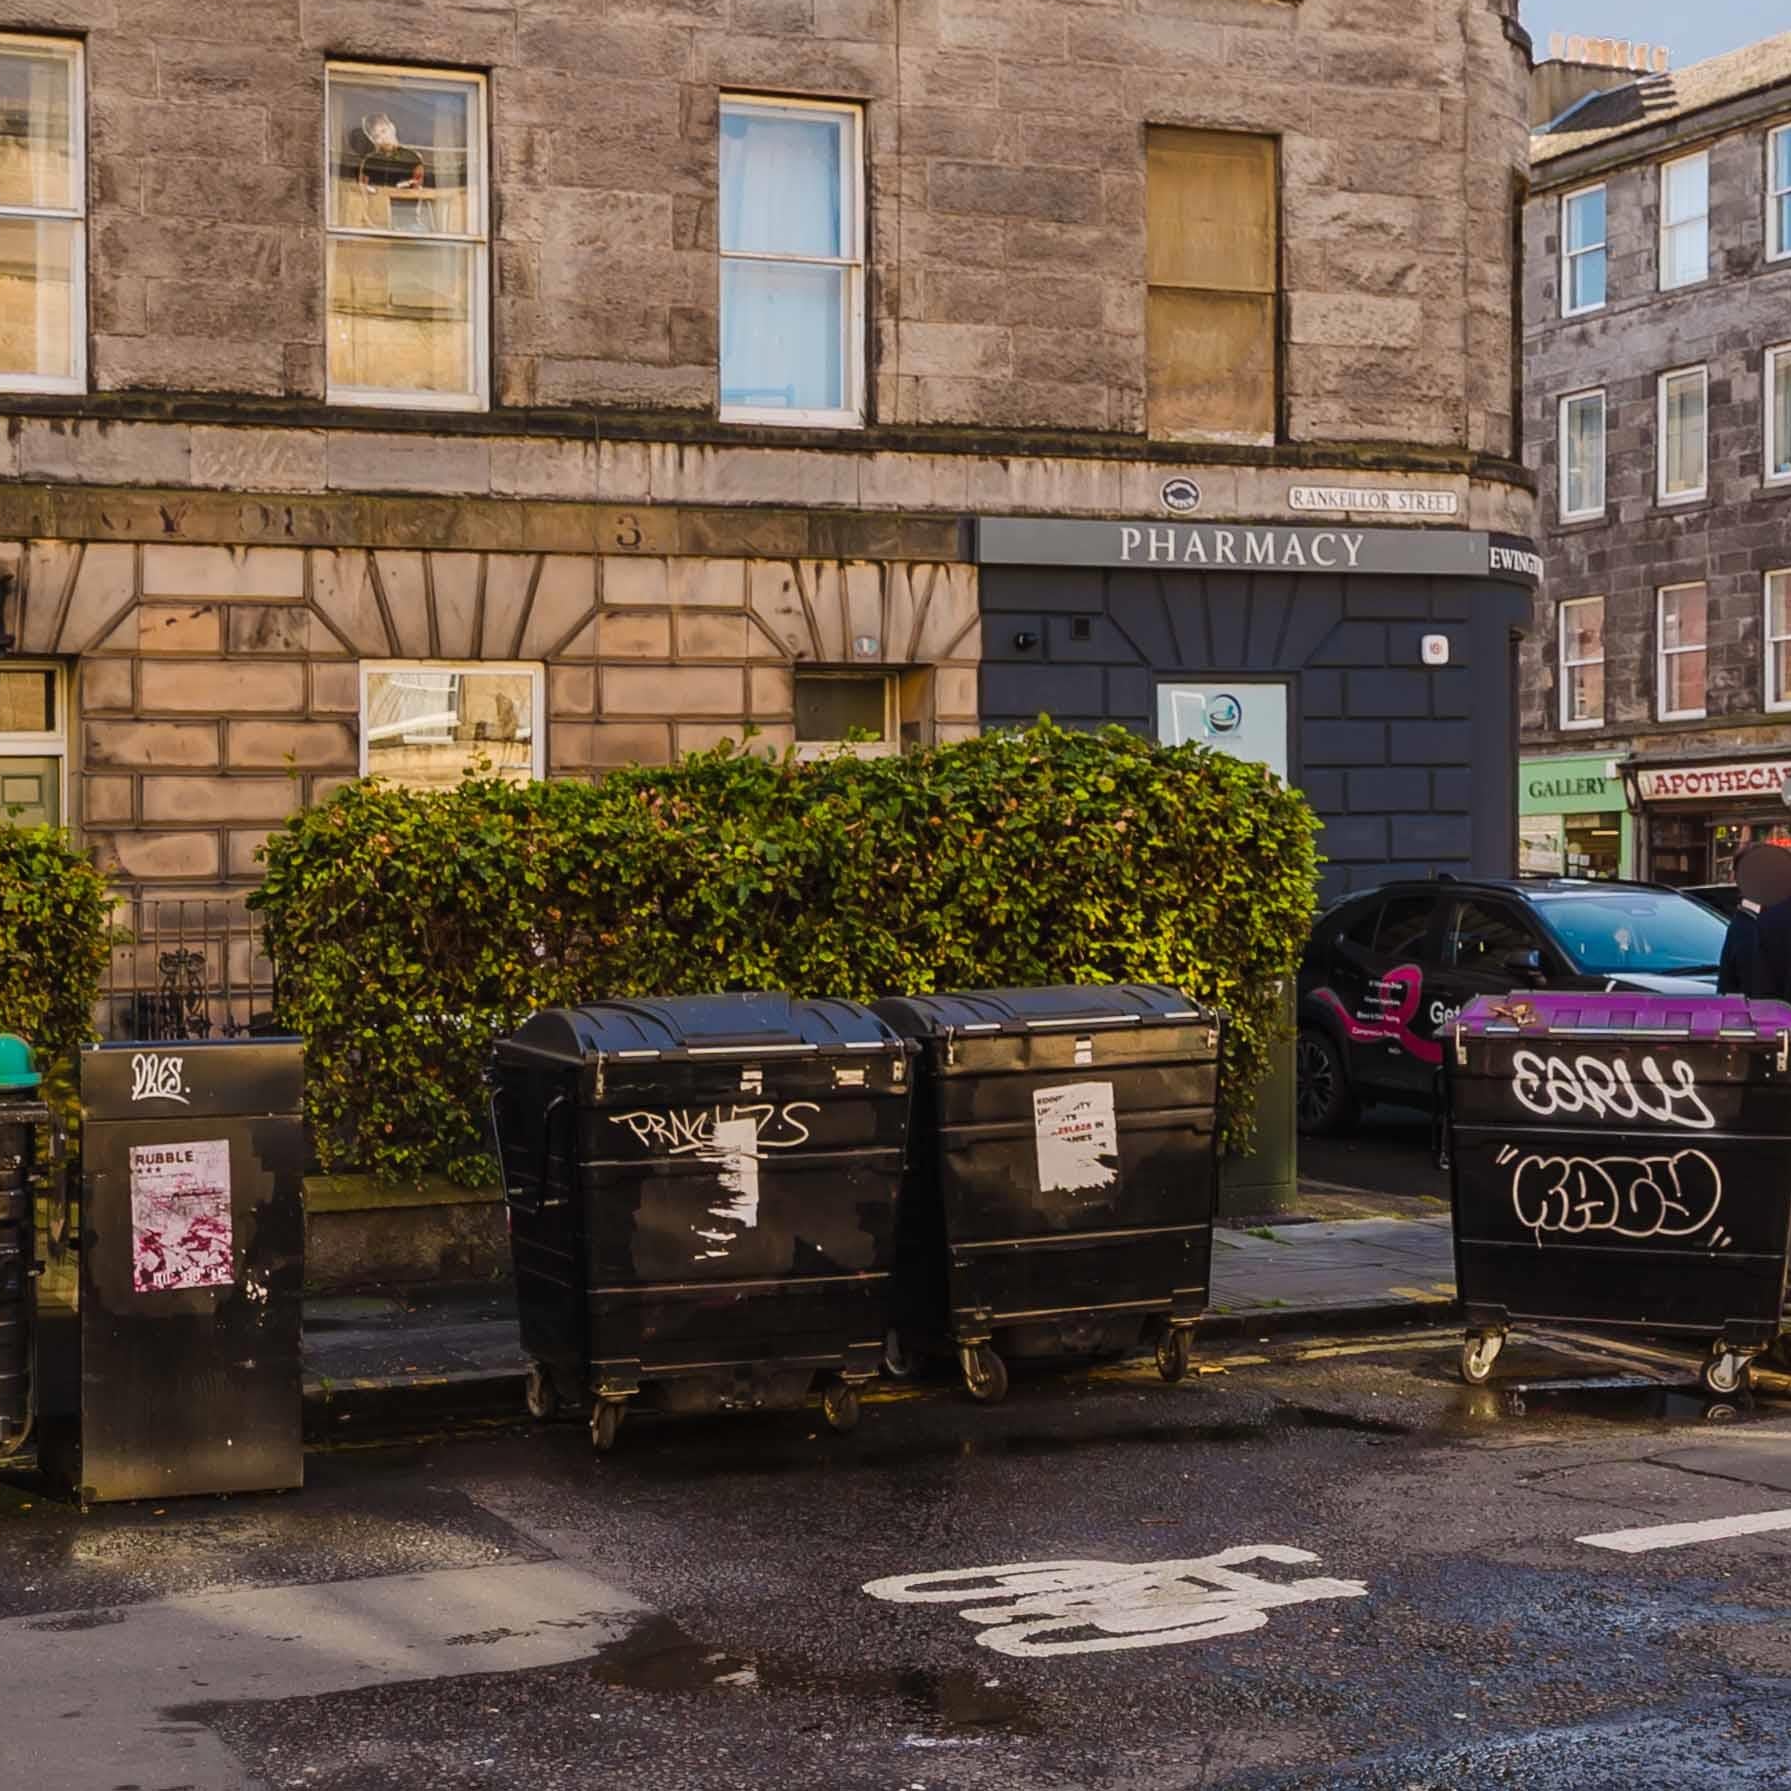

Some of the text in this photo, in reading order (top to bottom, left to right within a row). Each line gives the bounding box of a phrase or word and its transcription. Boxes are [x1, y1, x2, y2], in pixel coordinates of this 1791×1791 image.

[1293, 489, 1452, 511] RANKEILLOR STREET
[1119, 527, 1365, 567] PHARMACY
[1528, 775, 1608, 799] GALLERY
[135, 1150, 194, 1166] RUBBLE
